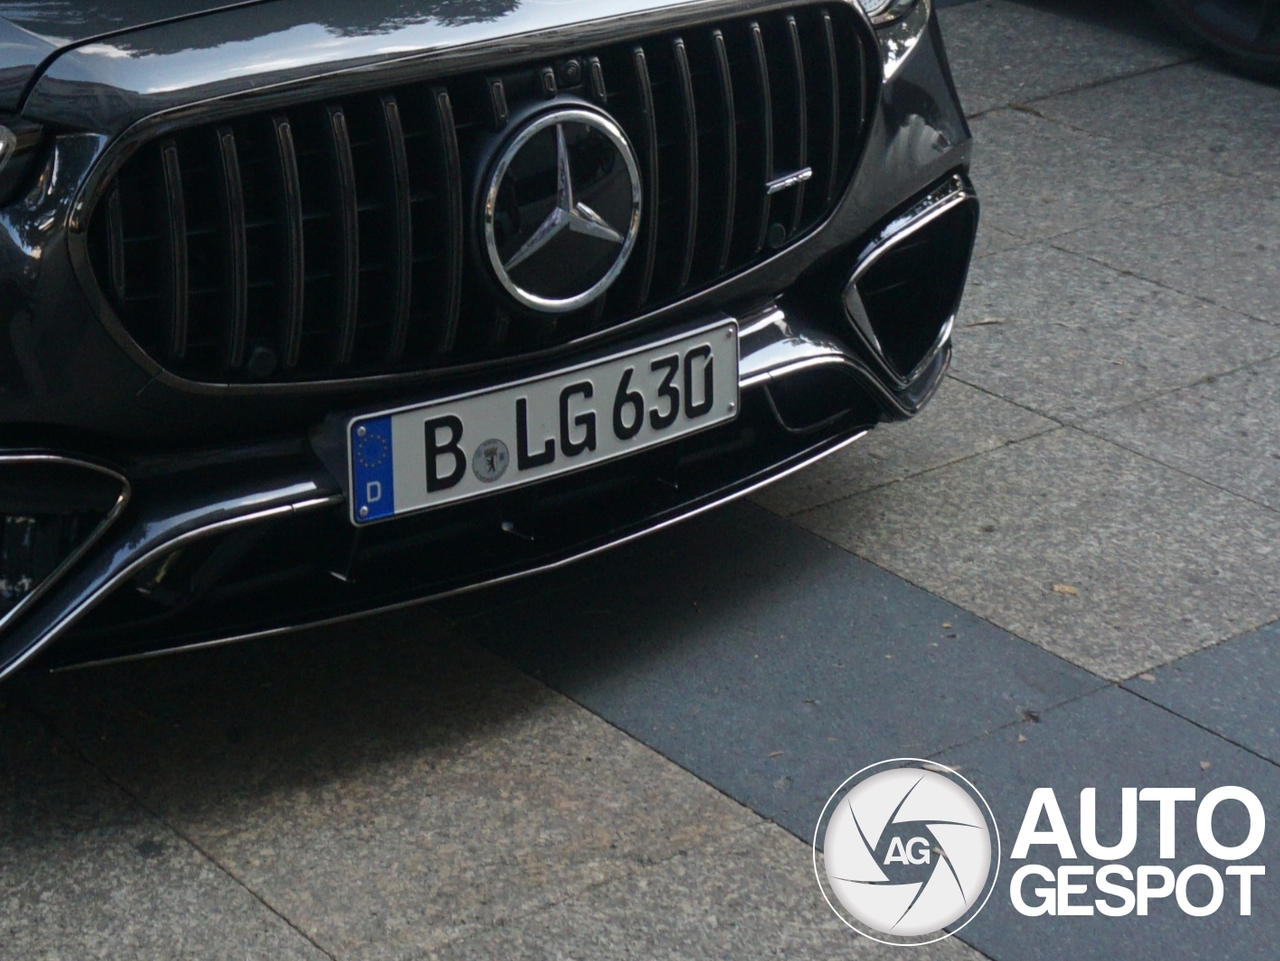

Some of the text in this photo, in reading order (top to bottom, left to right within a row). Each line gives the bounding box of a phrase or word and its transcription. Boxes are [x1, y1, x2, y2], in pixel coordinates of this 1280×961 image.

[424, 414, 467, 494] B
[515, 380, 597, 472] LG
[612, 343, 715, 441] 630
[366, 480, 383, 504] D
